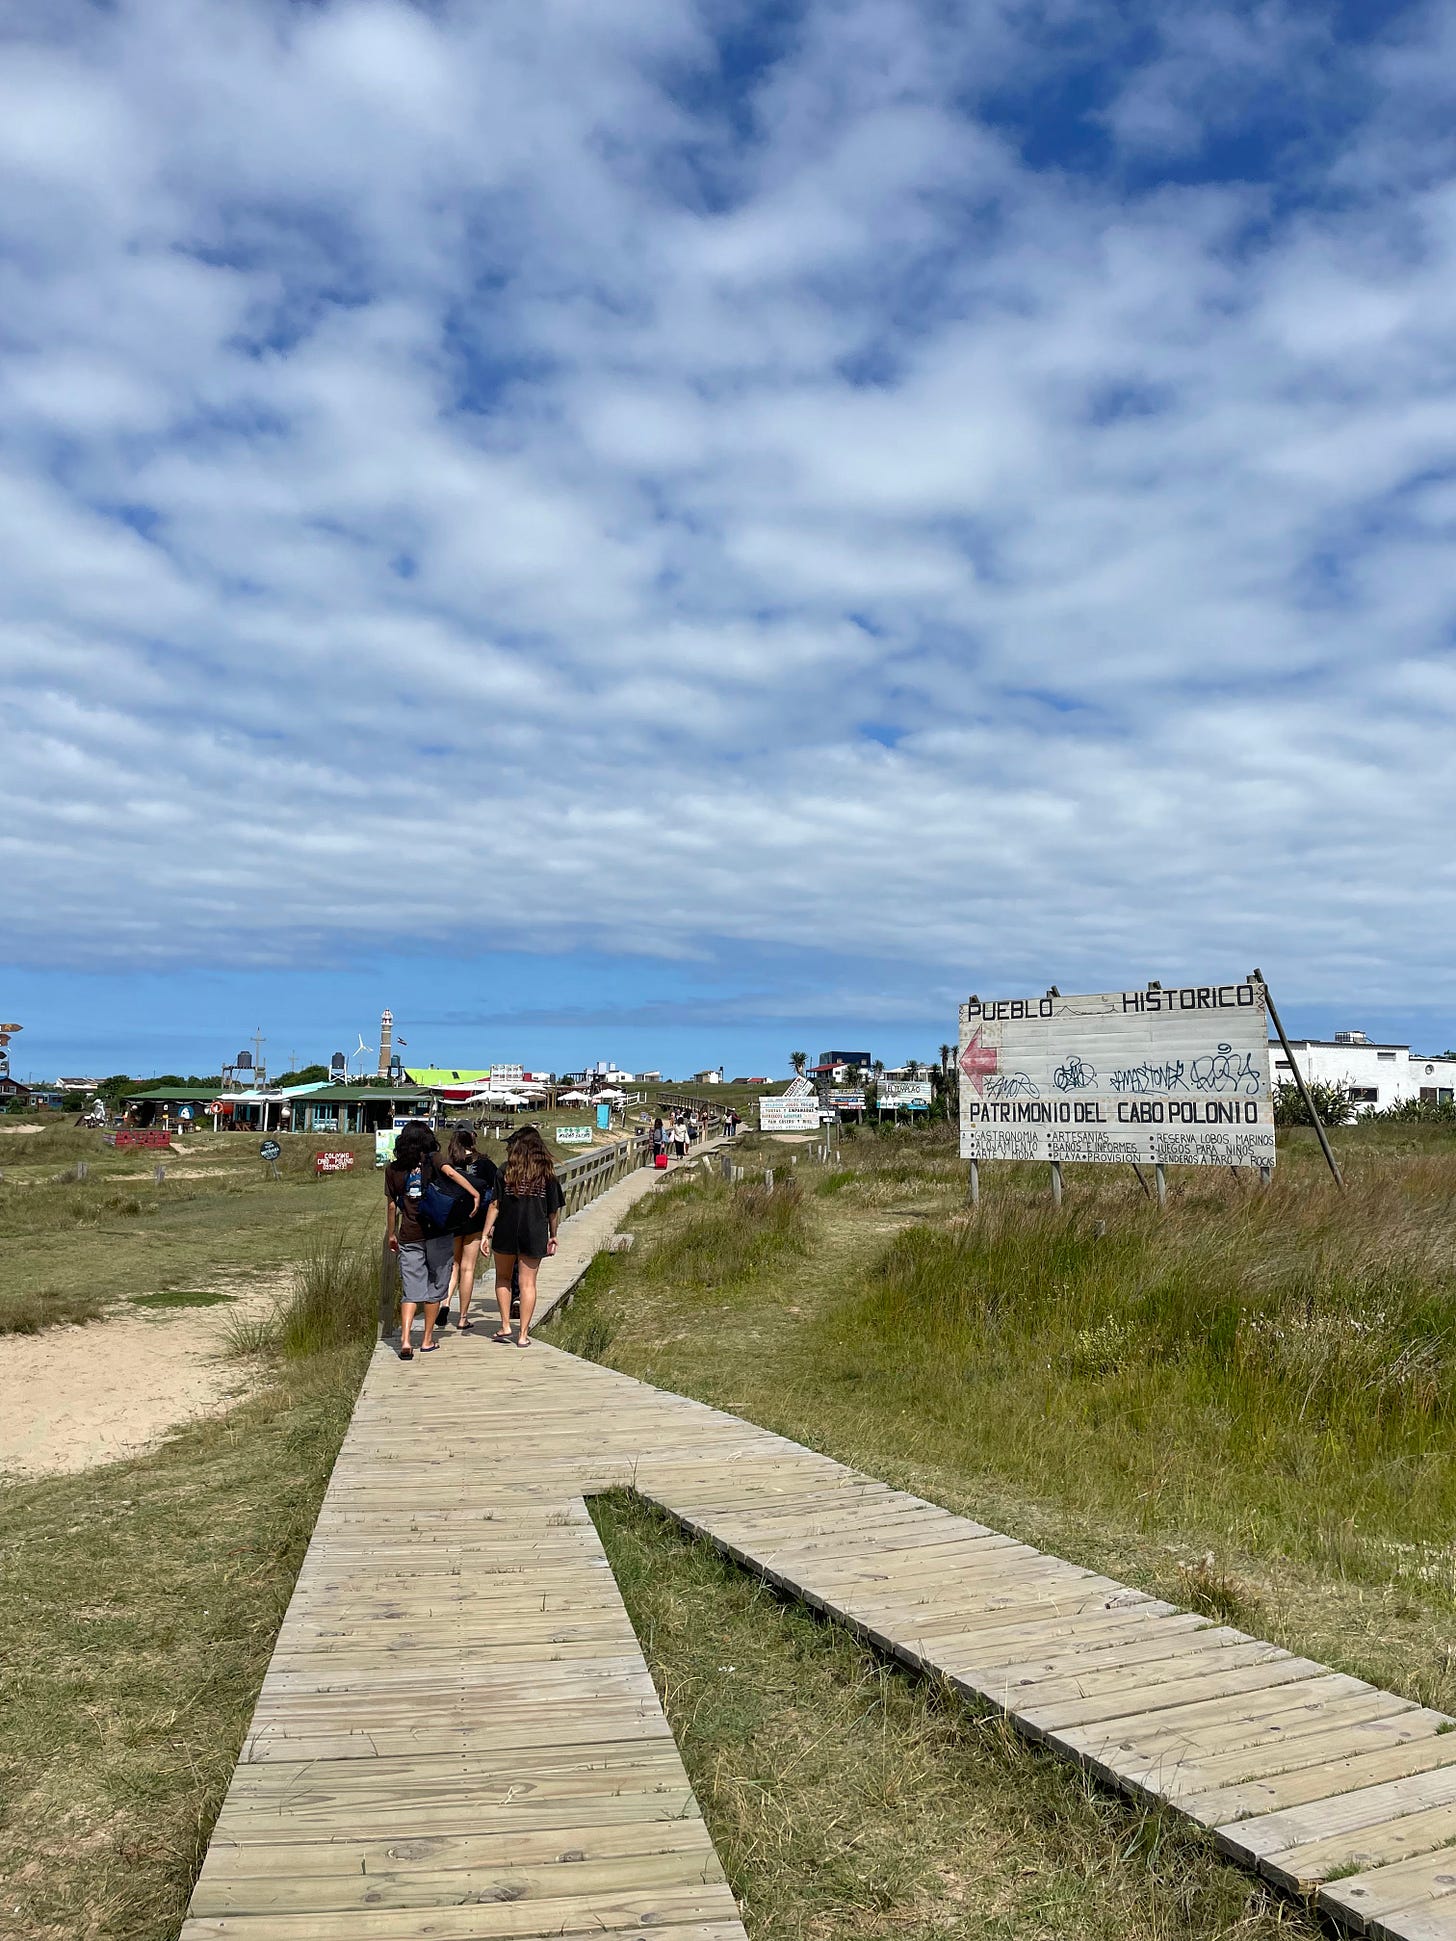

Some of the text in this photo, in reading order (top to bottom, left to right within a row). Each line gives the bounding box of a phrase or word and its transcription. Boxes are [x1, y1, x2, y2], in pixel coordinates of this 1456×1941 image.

[968, 998, 1053, 1022] PUEBLO
[970, 1101, 1258, 1124] PATRIMONIO DEL CABO POLONIO
[974, 1130, 1039, 1142] GASTRONOMIA
[1157, 1133, 1274, 1146] RESERVA LOBOS MARINOS
[974, 1140, 1038, 1152] ALOJAMIENTO
[1086, 1142, 1092, 1152] E
[1094, 1142, 1138, 1153] INFORMES
[1157, 1144, 1191, 1154] JUEGOS
[1196, 1144, 1218, 1155] PARA
[975, 1149, 1035, 1160] ARTE Y MODA
[1053, 1152, 1141, 1163] PLAYA PROVISION
[1158, 1154, 1275, 1167] SENDEROS A FARO Y ROCAS
